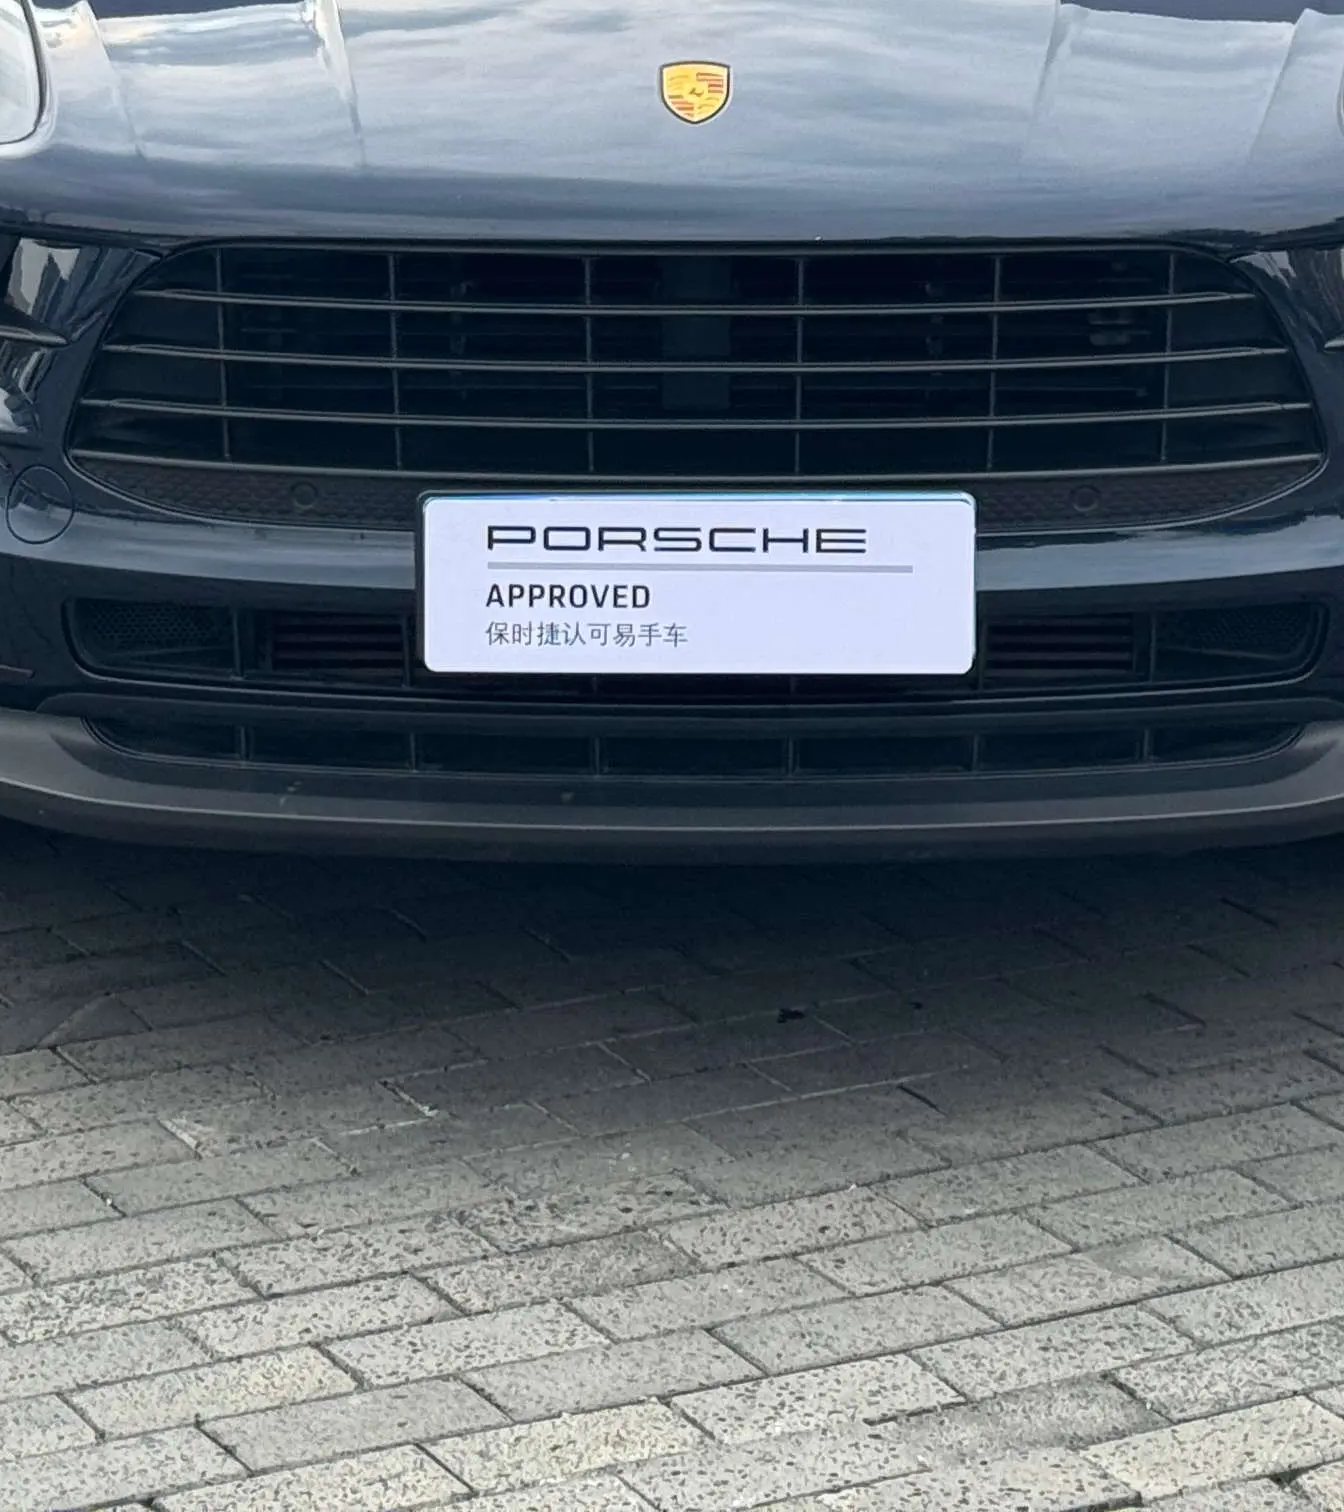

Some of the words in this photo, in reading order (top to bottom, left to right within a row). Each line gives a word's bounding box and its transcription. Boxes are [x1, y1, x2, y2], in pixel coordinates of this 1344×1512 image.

[486, 525, 867, 554] PORSCHE
[485, 583, 651, 609] APPROVED
[484, 620, 688, 648] 保时捷认可易手车
